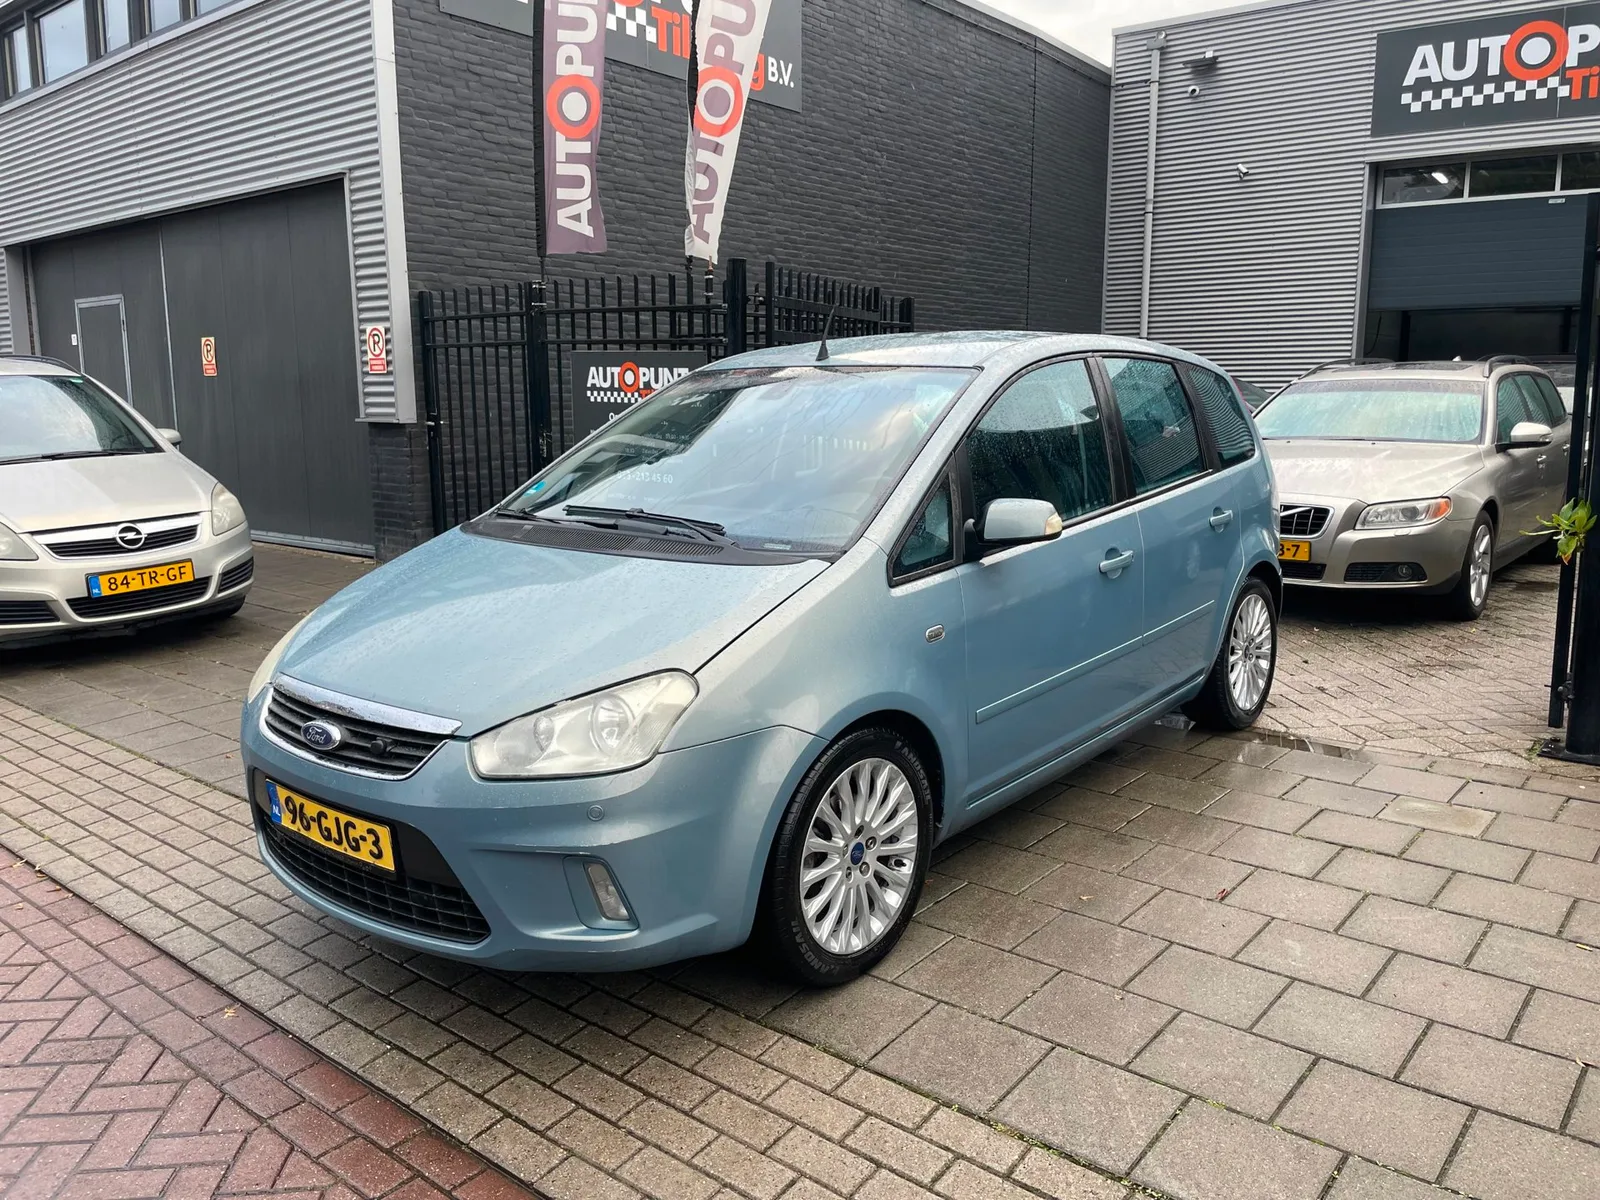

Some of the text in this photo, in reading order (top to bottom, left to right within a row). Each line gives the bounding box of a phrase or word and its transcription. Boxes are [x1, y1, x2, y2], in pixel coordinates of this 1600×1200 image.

[768, 55, 794, 88] B.V.
[546, 0, 600, 238] AUTOPU
[107, 565, 187, 592] 84-TR-GF
[306, 726, 327, 745] Ford
[272, 803, 281, 817] NL
[284, 795, 385, 861] 96-GJG-3
